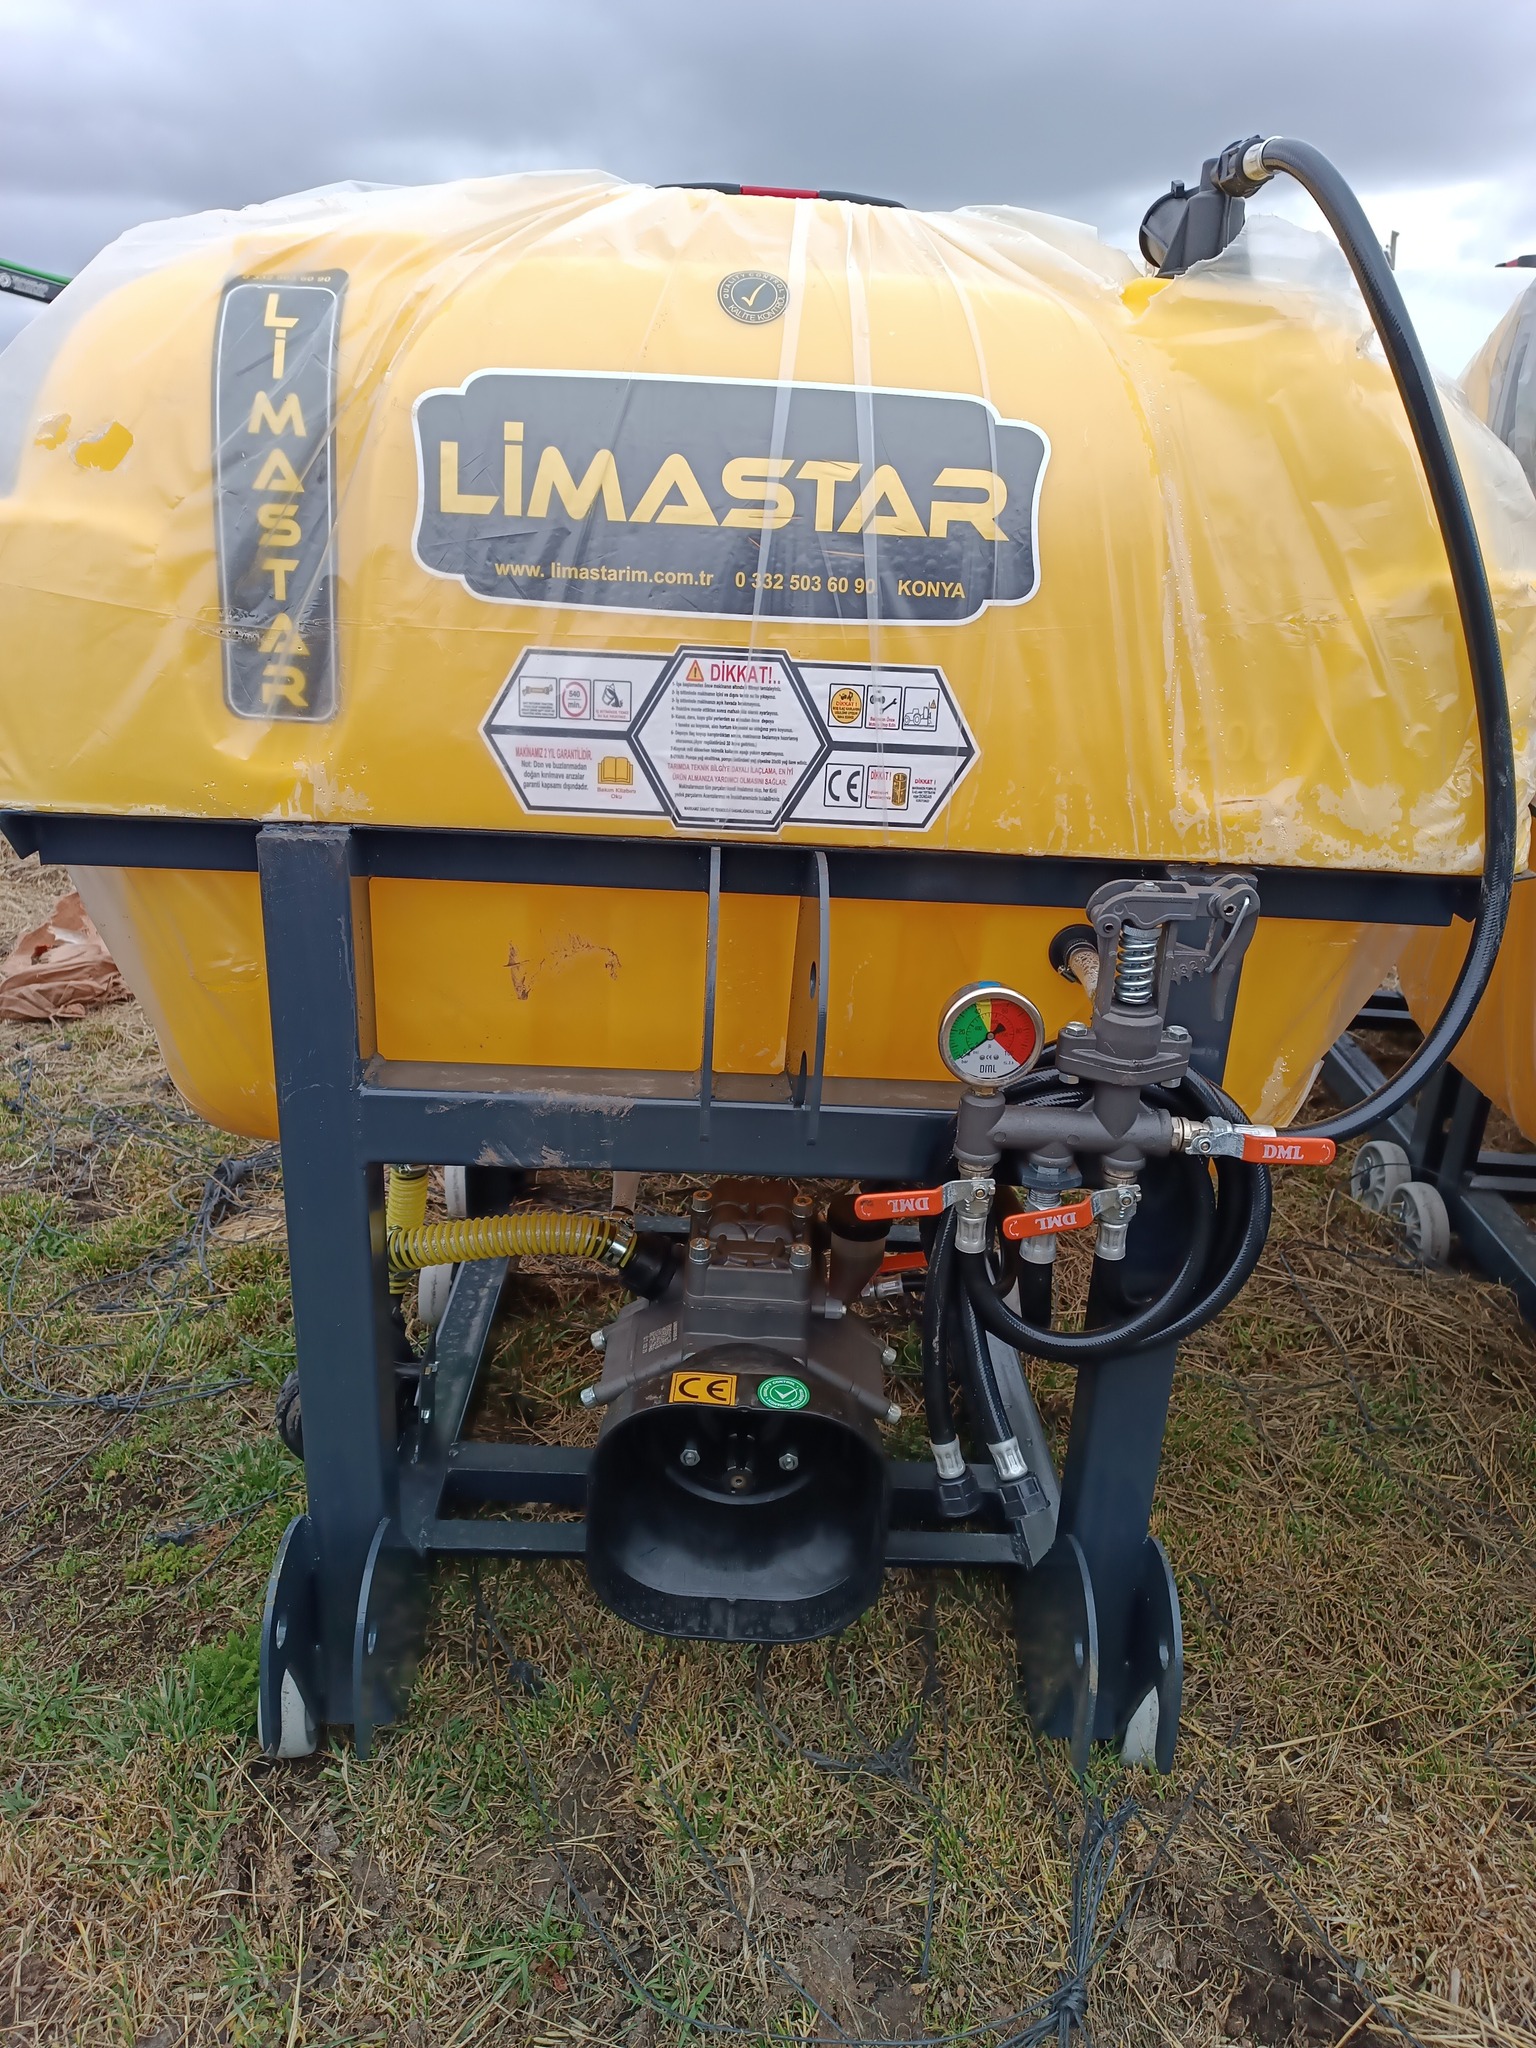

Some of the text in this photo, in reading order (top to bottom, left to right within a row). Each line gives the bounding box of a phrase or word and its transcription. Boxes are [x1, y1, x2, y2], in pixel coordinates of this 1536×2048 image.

[723, 272, 785, 299] QUALITY CONTROL
[758, 294, 786, 321] KONTROL
[440, 421, 1010, 541] LİMASTAR
[248, 292, 309, 708] LİMASTAR
[495, 562, 966, 599] www. limastarim.com.tr 0 332 503 60 90 KONYA
[548, 749, 556, 759] YIL
[691, 763, 709, 771] TEKNİK
[828, 770, 860, 802] CE
[980, 1064, 997, 1073] DML
[1262, 1144, 1304, 1160] DML
[888, 1197, 929, 1212] DML
[1035, 1212, 1076, 1230] DML
[678, 1377, 728, 1401] CE
